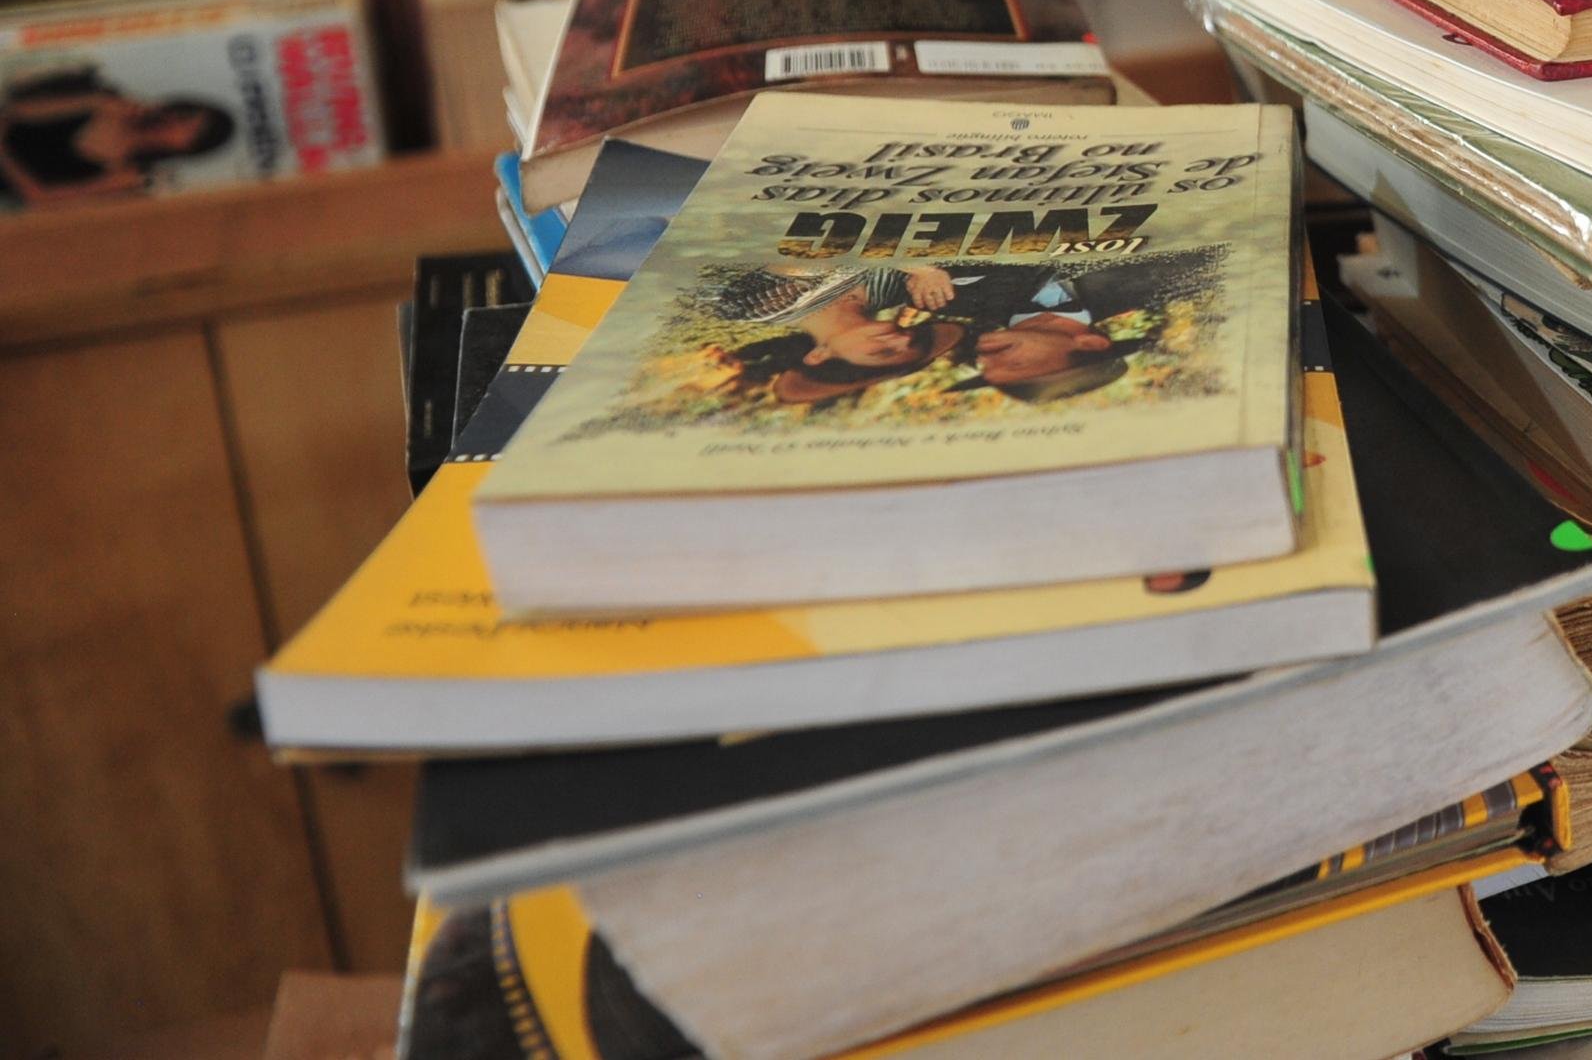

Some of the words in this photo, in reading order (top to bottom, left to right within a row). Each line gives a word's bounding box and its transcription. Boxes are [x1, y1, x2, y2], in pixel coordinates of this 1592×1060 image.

[863, 141, 1055, 164] Brasil
[1083, 141, 1161, 158] no
[746, 153, 948, 187] Zweig
[970, 159, 1163, 184] Stefan
[1185, 153, 1261, 177] de
[753, 183, 891, 210] dias
[908, 179, 1149, 207] últimos
[1165, 175, 1238, 195] os
[777, 204, 1158, 259] ZWEIG
[1050, 235, 1144, 258] lost
